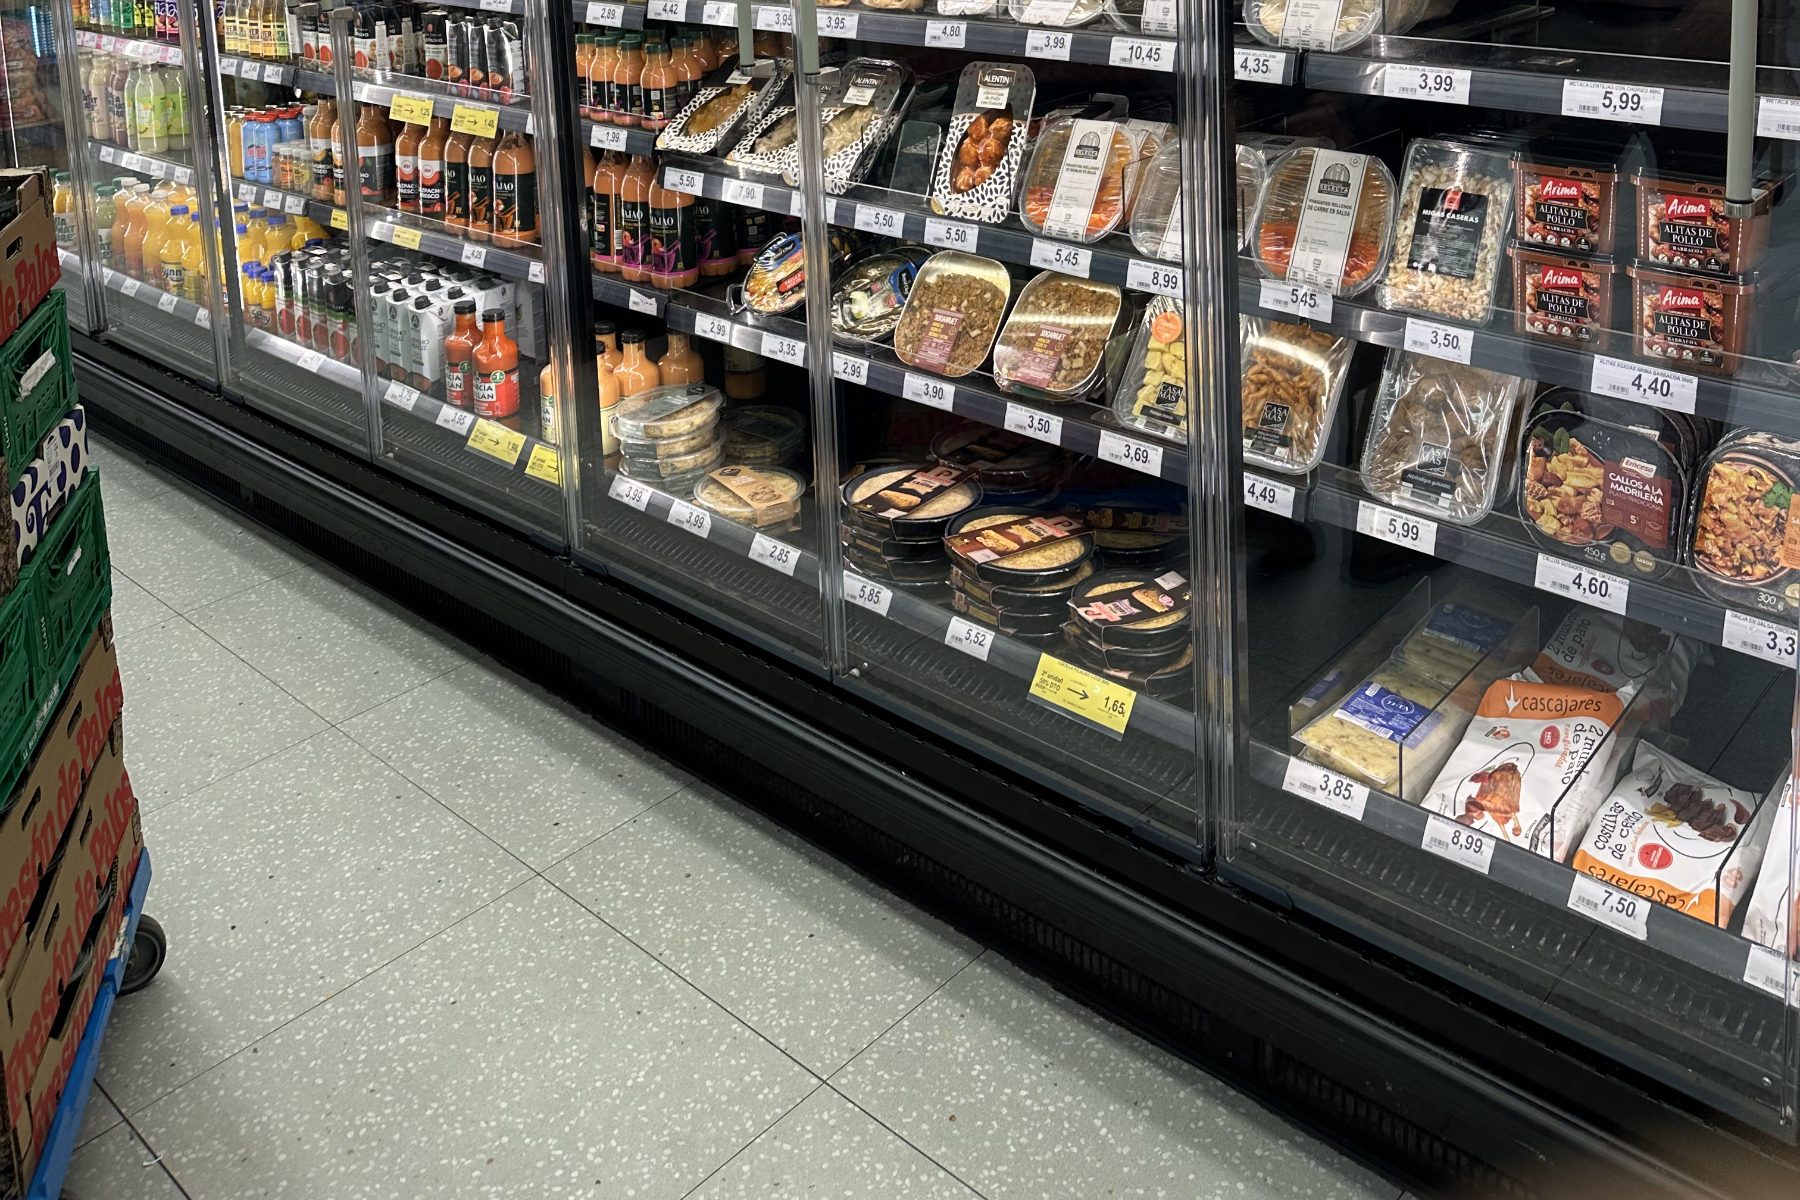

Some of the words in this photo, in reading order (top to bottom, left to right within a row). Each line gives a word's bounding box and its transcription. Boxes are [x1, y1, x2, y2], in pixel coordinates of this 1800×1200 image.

[1543, 181, 1578, 196] Arima
[1539, 205, 1568, 216] ALITAS
[1571, 209, 1583, 219] DE
[1668, 200, 1706, 214] Arima
[1422, 209, 1445, 217] MIGAS
[1446, 212, 1479, 223] CASERAS
[1546, 214, 1575, 226] POLLO
[1664, 225, 1696, 235] ALITAS
[1699, 228, 1712, 239] DE
[1672, 233, 1704, 245] POLLO
[14, 240, 62, 312] Palos
[1152, 271, 1177, 289] 8,99
[1544, 270, 1579, 285] Arima
[1540, 293, 1569, 305] ALITAS
[1571, 297, 1584, 308] DE
[1662, 290, 1700, 306] Arima
[1548, 303, 1577, 315] POLLO
[1659, 315, 1691, 327] ALITAS
[1692, 319, 1706, 330] DE
[1667, 325, 1698, 337] POLLO
[1161, 384, 1181, 396] CASA
[1265, 404, 1287, 416] CASA
[1423, 445, 1447, 458] CASA
[1625, 459, 1653, 473] Emcesa
[1609, 473, 1642, 489] CALLOS
[1652, 486, 1663, 496] LA
[1610, 482, 1663, 505] MADRILEÑA
[1584, 546, 1600, 557] 450
[1758, 592, 1777, 605] 300
[1048, 674, 1064, 683] unidad
[1050, 681, 1060, 691] DTO
[1522, 694, 1602, 715] cascajares
[1545, 731, 1551, 743] NO
[1573, 723, 1587, 744] de
[1589, 725, 1604, 737] 2
[56, 758, 81, 831] de
[76, 665, 124, 781] Palos
[89, 771, 136, 867] Palos
[1594, 802, 1624, 850] costillas
[1608, 843, 1626, 860] de
